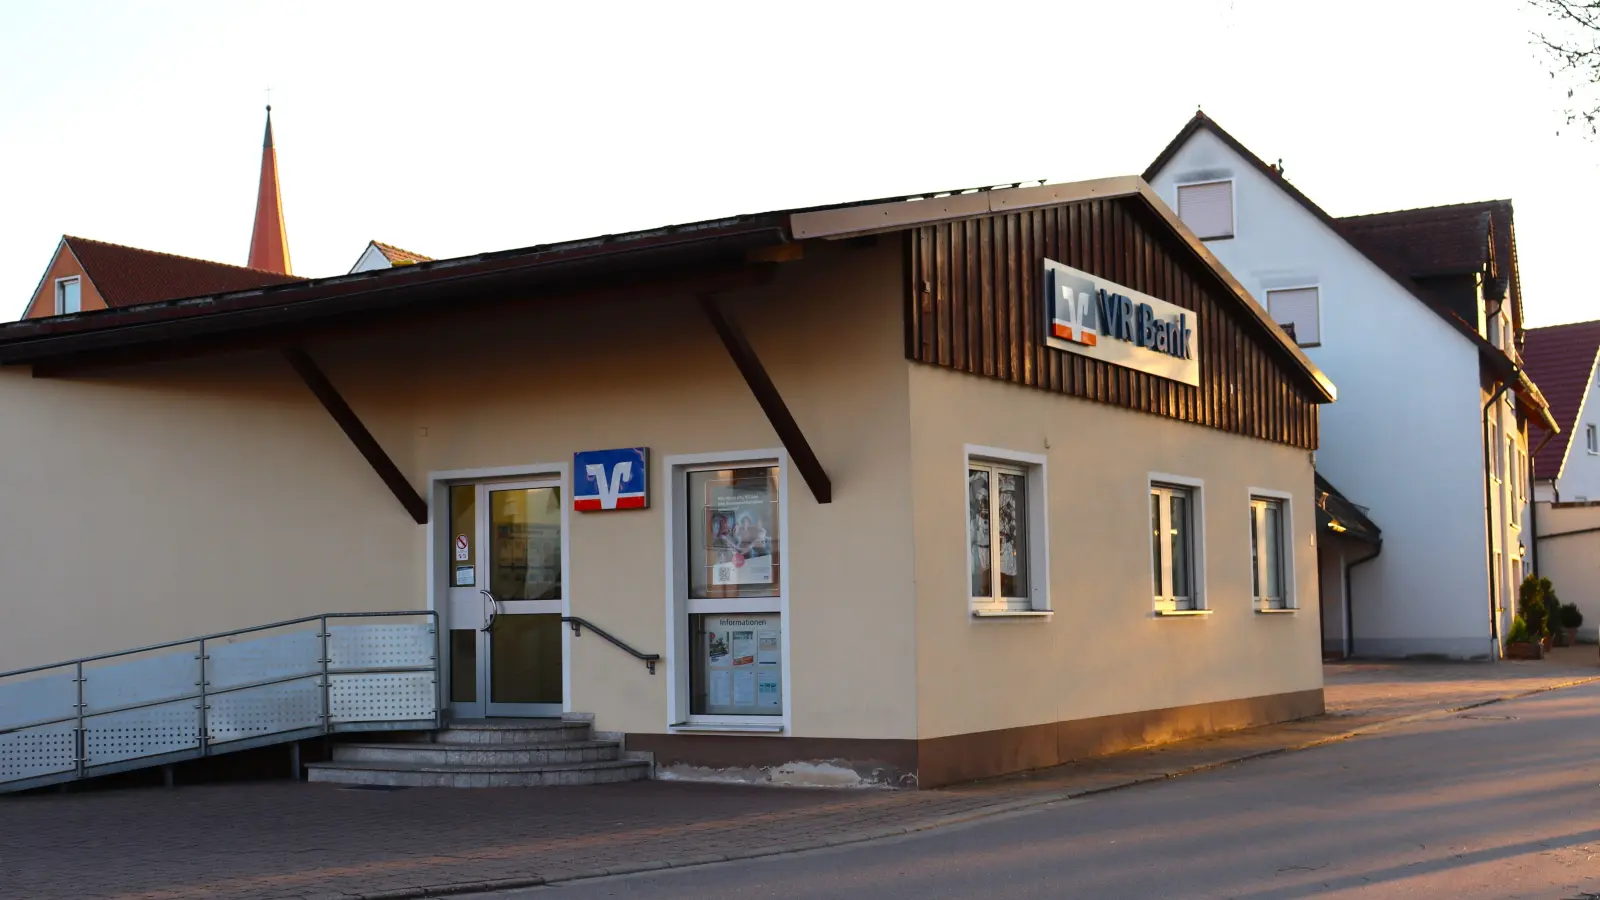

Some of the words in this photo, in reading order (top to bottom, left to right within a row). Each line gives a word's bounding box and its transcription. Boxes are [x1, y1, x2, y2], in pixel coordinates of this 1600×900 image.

[1100, 288, 1135, 344] VR
[1138, 302, 1192, 360] Bank
[720, 618, 767, 626] Informationen
